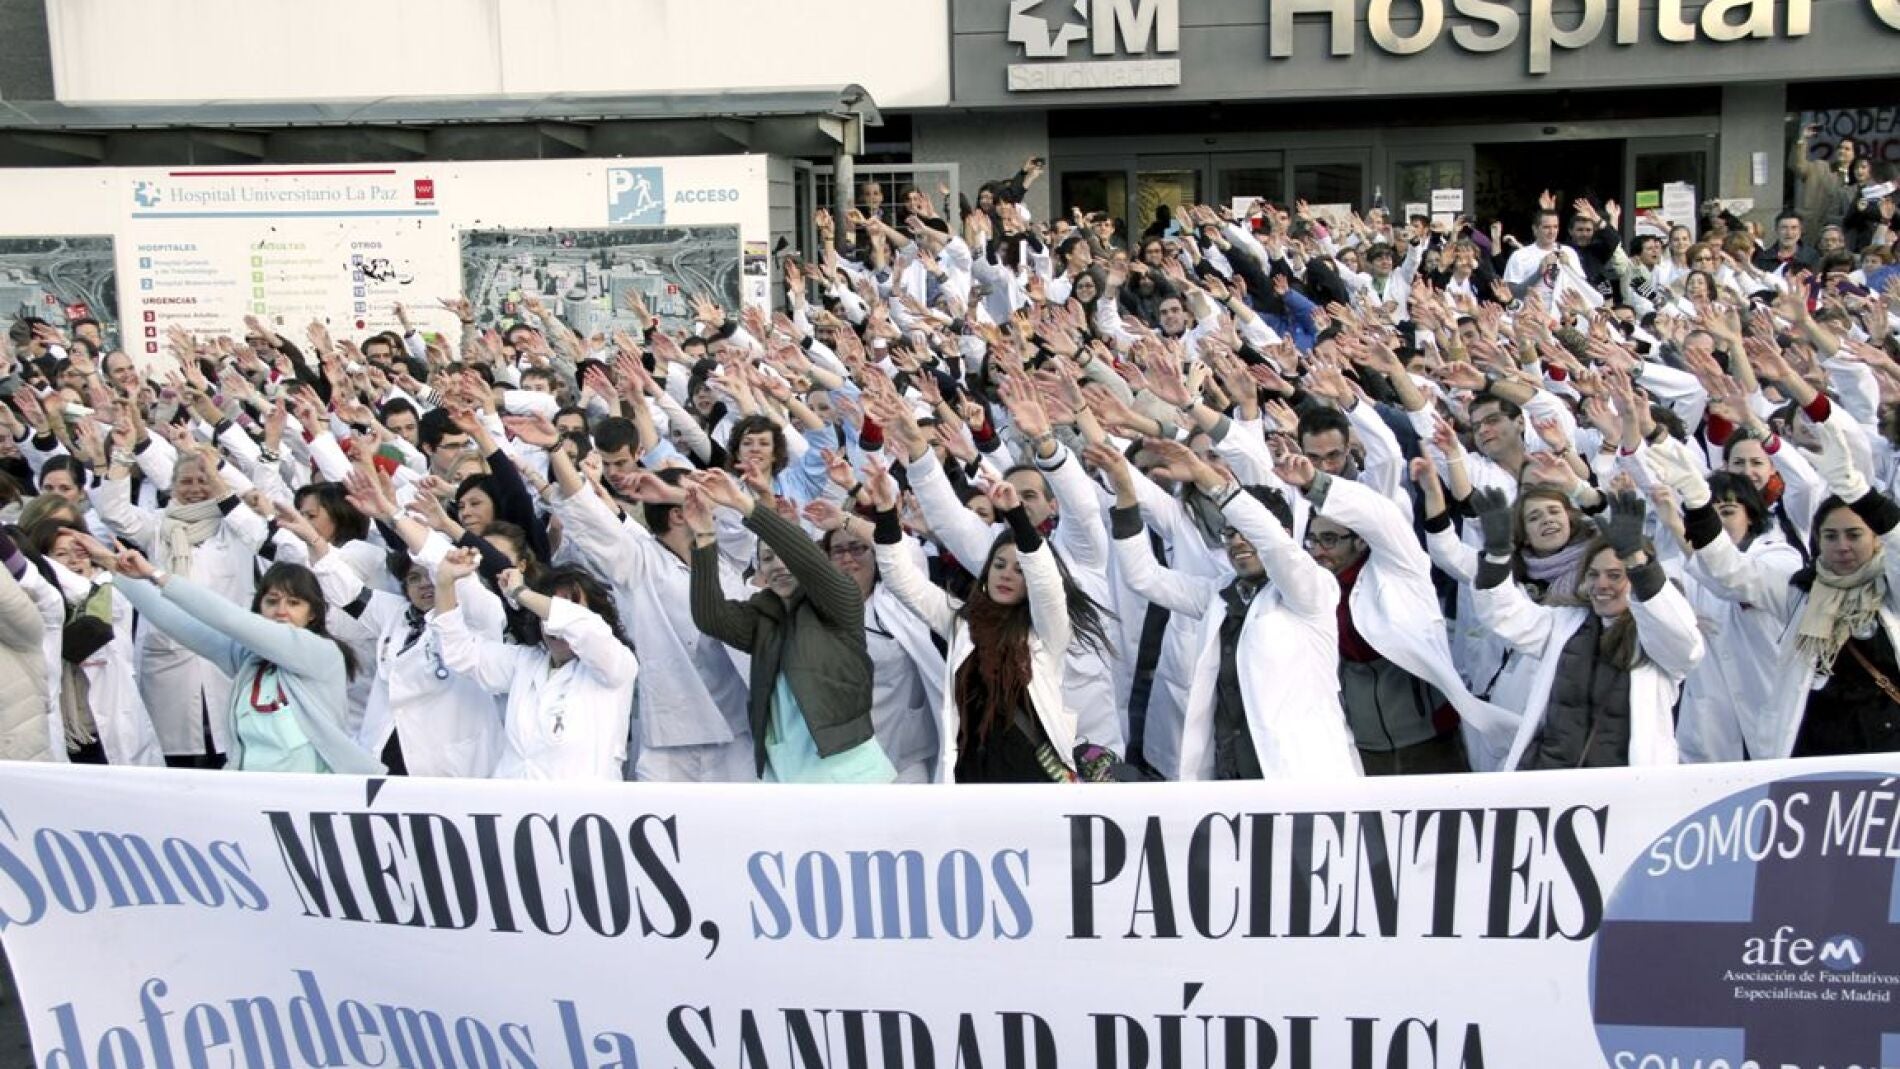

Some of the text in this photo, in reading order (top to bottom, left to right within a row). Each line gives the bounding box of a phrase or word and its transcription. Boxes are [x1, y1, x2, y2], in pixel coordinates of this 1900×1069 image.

[1092, 0, 1180, 54] M
[169, 184, 398, 205] Hospital Universitario La Paz
[608, 169, 635, 205] P
[674, 188, 739, 203] ACCESO
[1647, 791, 1810, 877] SOMOS
[0, 778, 1609, 960] Somos MÉDICOS, somos PACIENTES
[1723, 969, 1900, 985] Asociación de Facultativos
[1734, 987, 1890, 1002] Especialistas de Madrid
